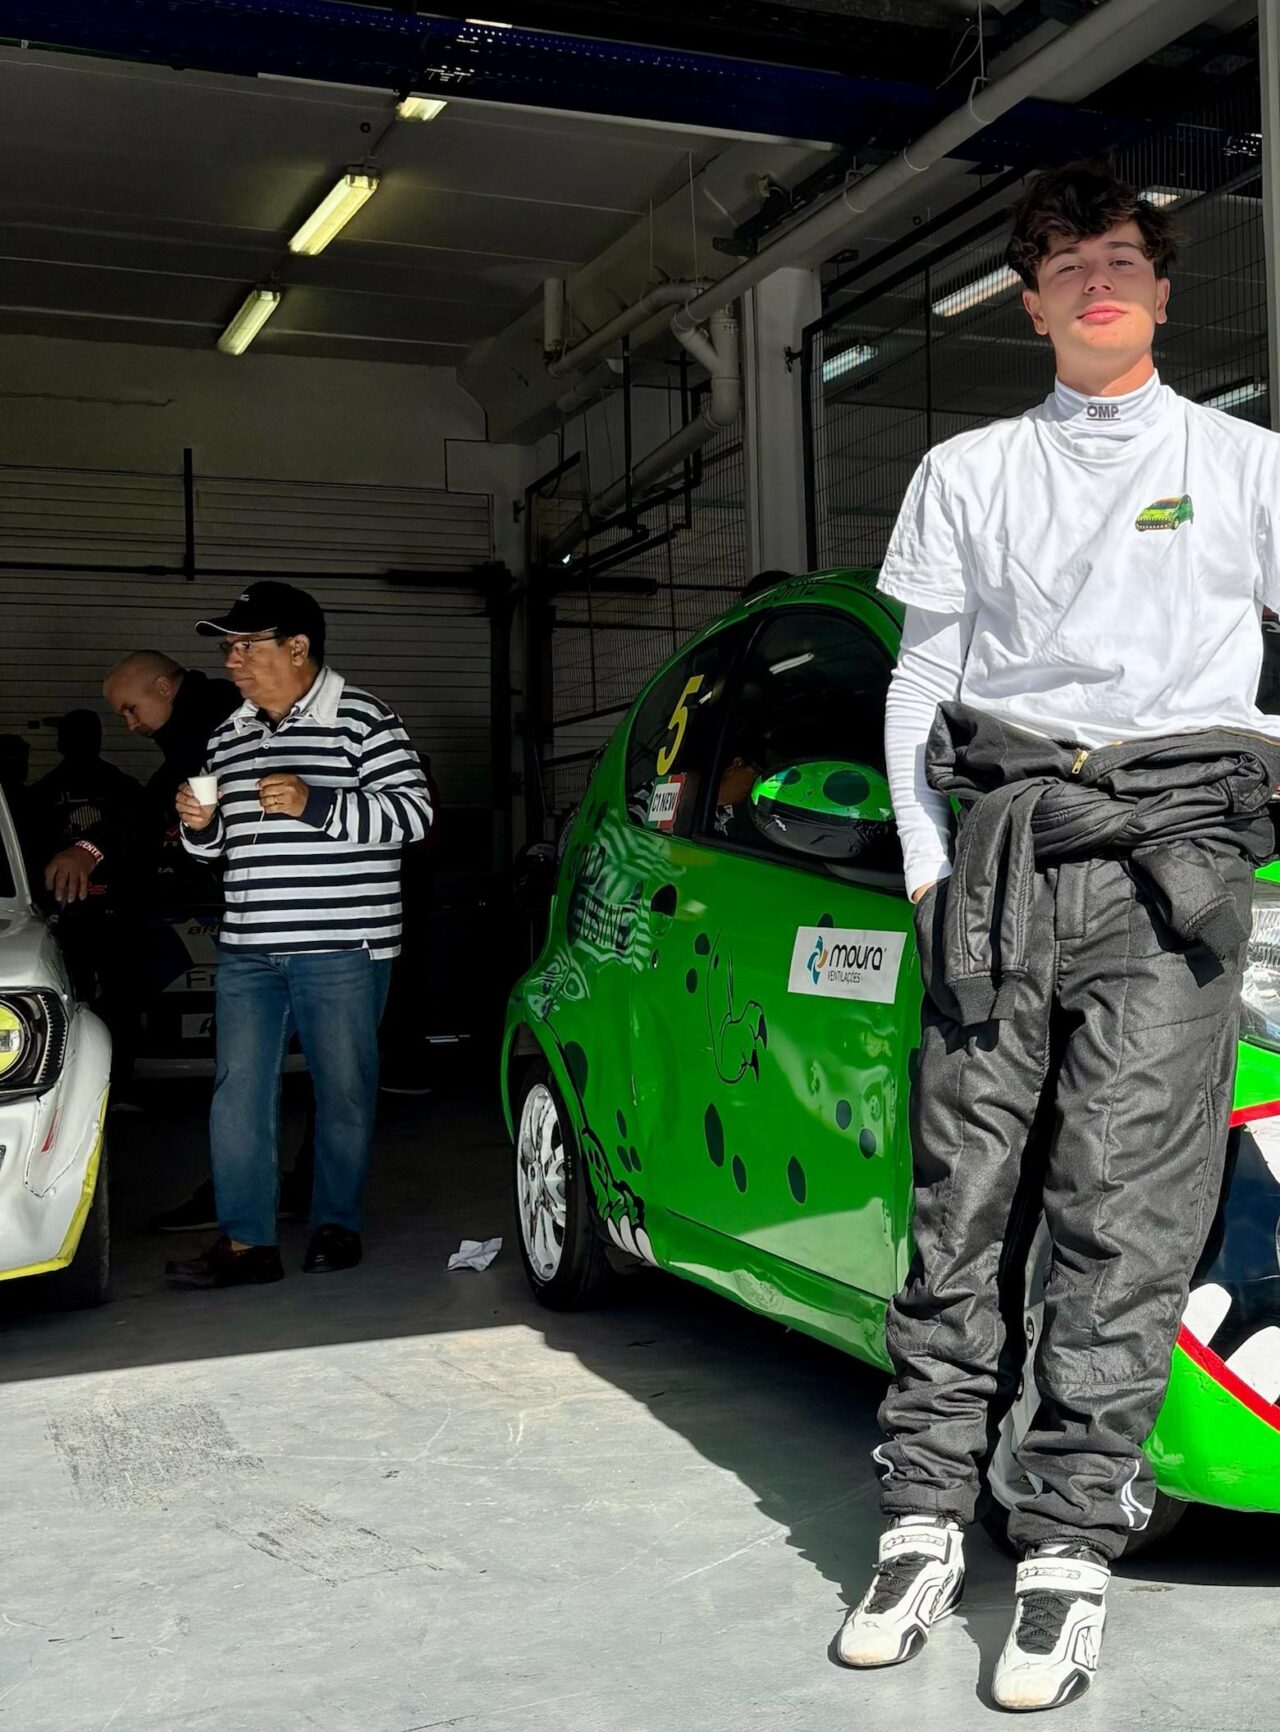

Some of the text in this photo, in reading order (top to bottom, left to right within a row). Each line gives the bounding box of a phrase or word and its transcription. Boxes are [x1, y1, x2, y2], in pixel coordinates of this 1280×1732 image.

[1087, 405, 1119, 418] OMP
[657, 674, 704, 776] 5
[829, 944, 883, 971] moura
